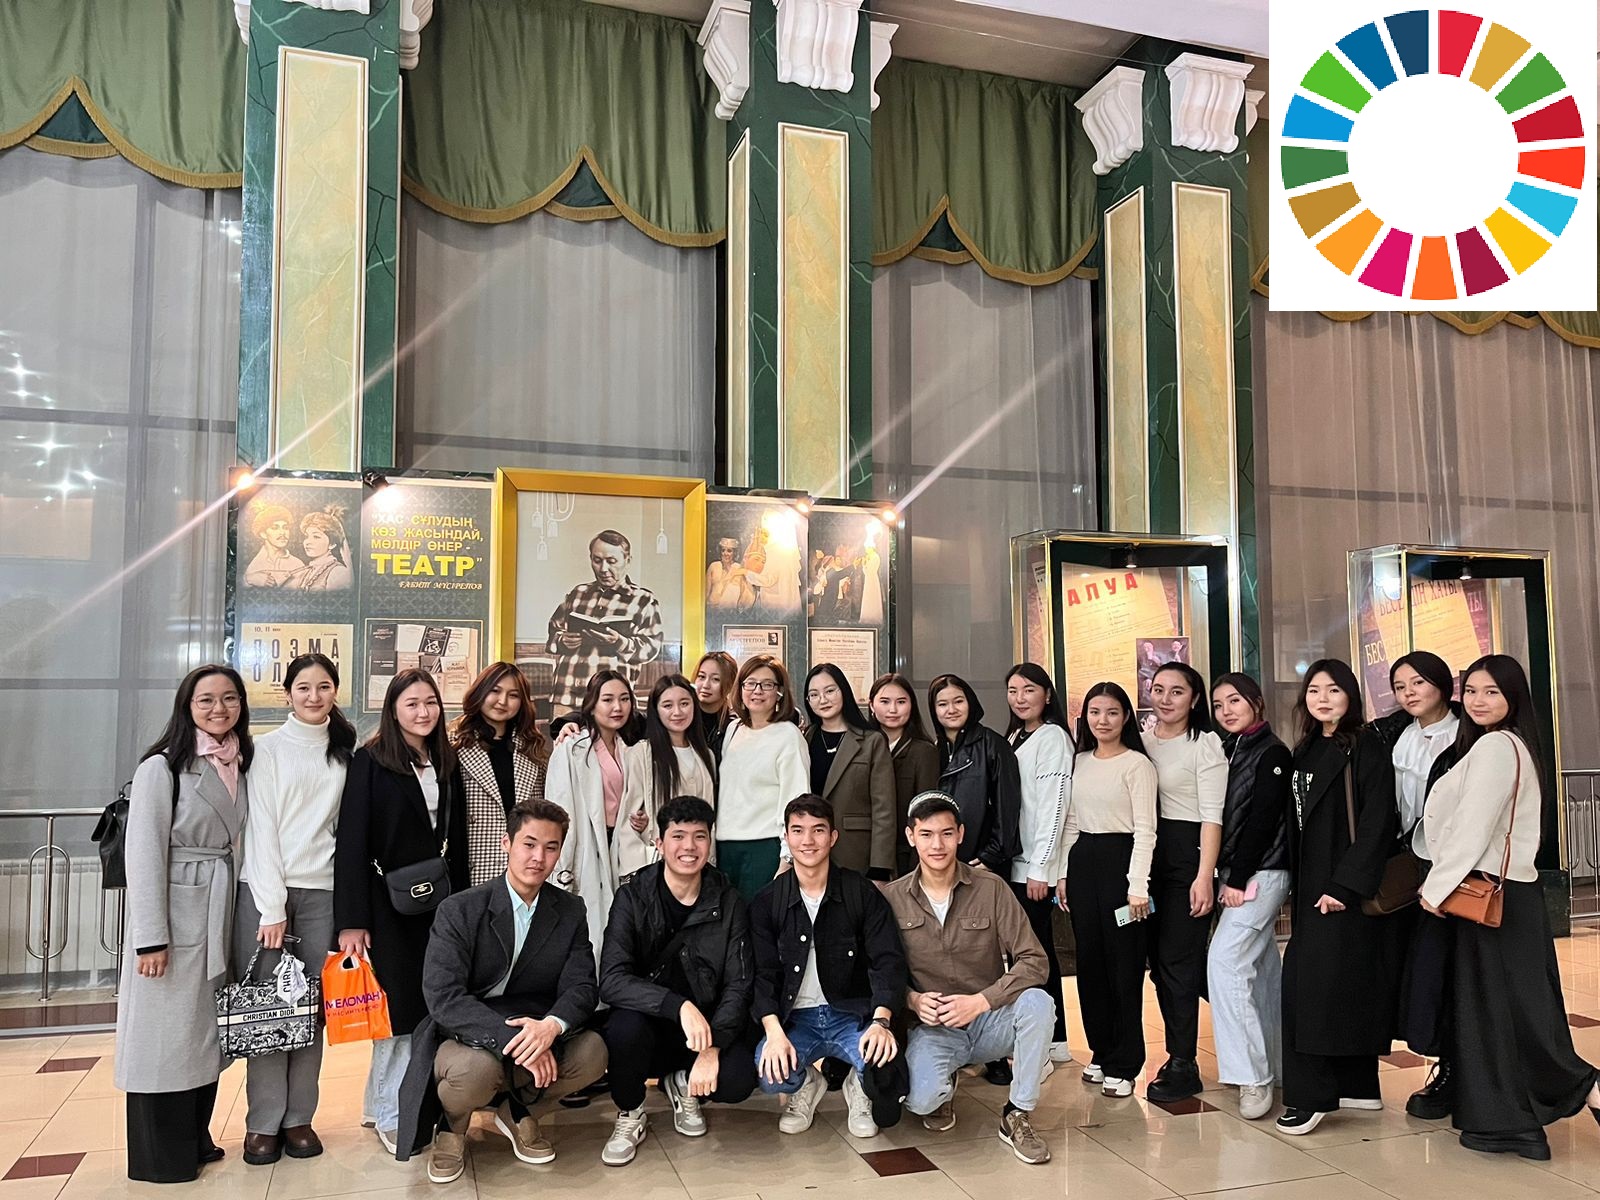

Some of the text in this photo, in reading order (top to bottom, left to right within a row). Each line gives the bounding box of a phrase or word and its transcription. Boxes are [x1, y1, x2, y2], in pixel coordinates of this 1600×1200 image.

[411, 515, 473, 528] СҰЛУДЫҢ
[371, 526, 484, 542] КӨЗ ЖАСЫНДАЙ,
[371, 539, 421, 551] МӨЛДІР
[427, 541, 463, 552] ӨНЕР
[325, 991, 380, 1010] МЕЛОМАН
[243, 1008, 295, 1022] CHRISTIAN DIOR
